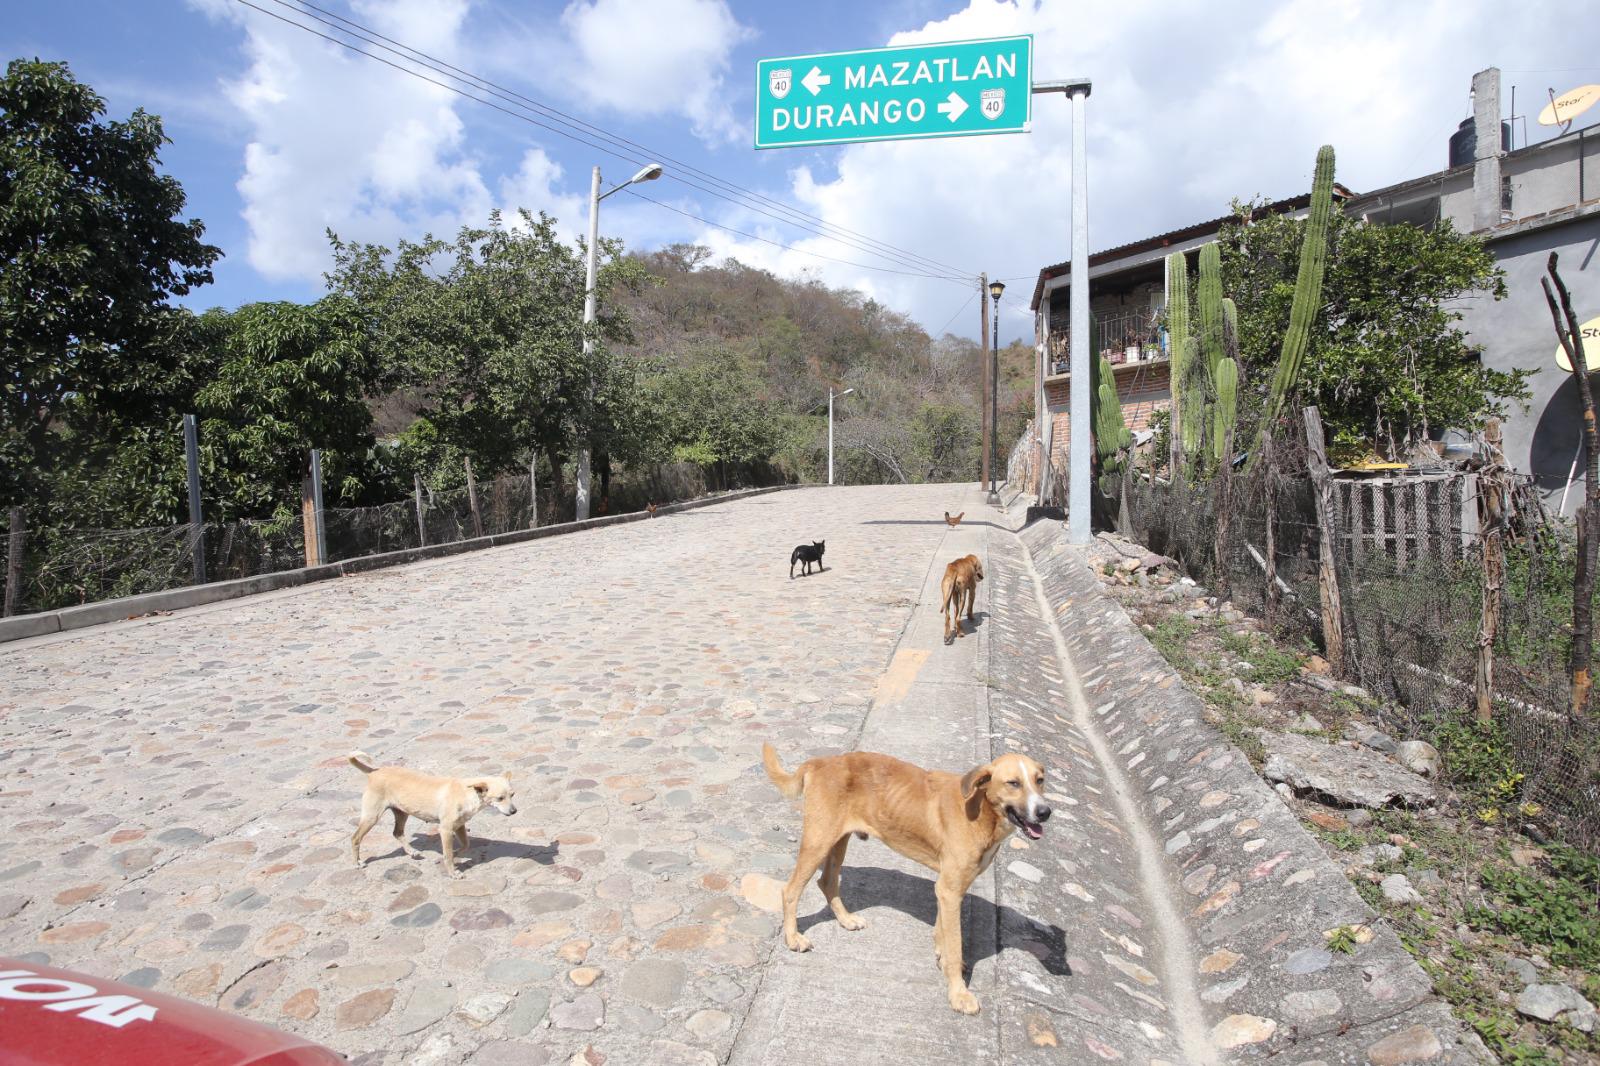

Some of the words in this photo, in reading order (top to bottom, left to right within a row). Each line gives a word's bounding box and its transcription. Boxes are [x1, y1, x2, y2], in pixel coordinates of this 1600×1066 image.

[844, 53, 1017, 90] MAZATLAN
[774, 81, 787, 91] 40
[772, 98, 926, 131] DURANGO
[985, 101, 1000, 112] 40
